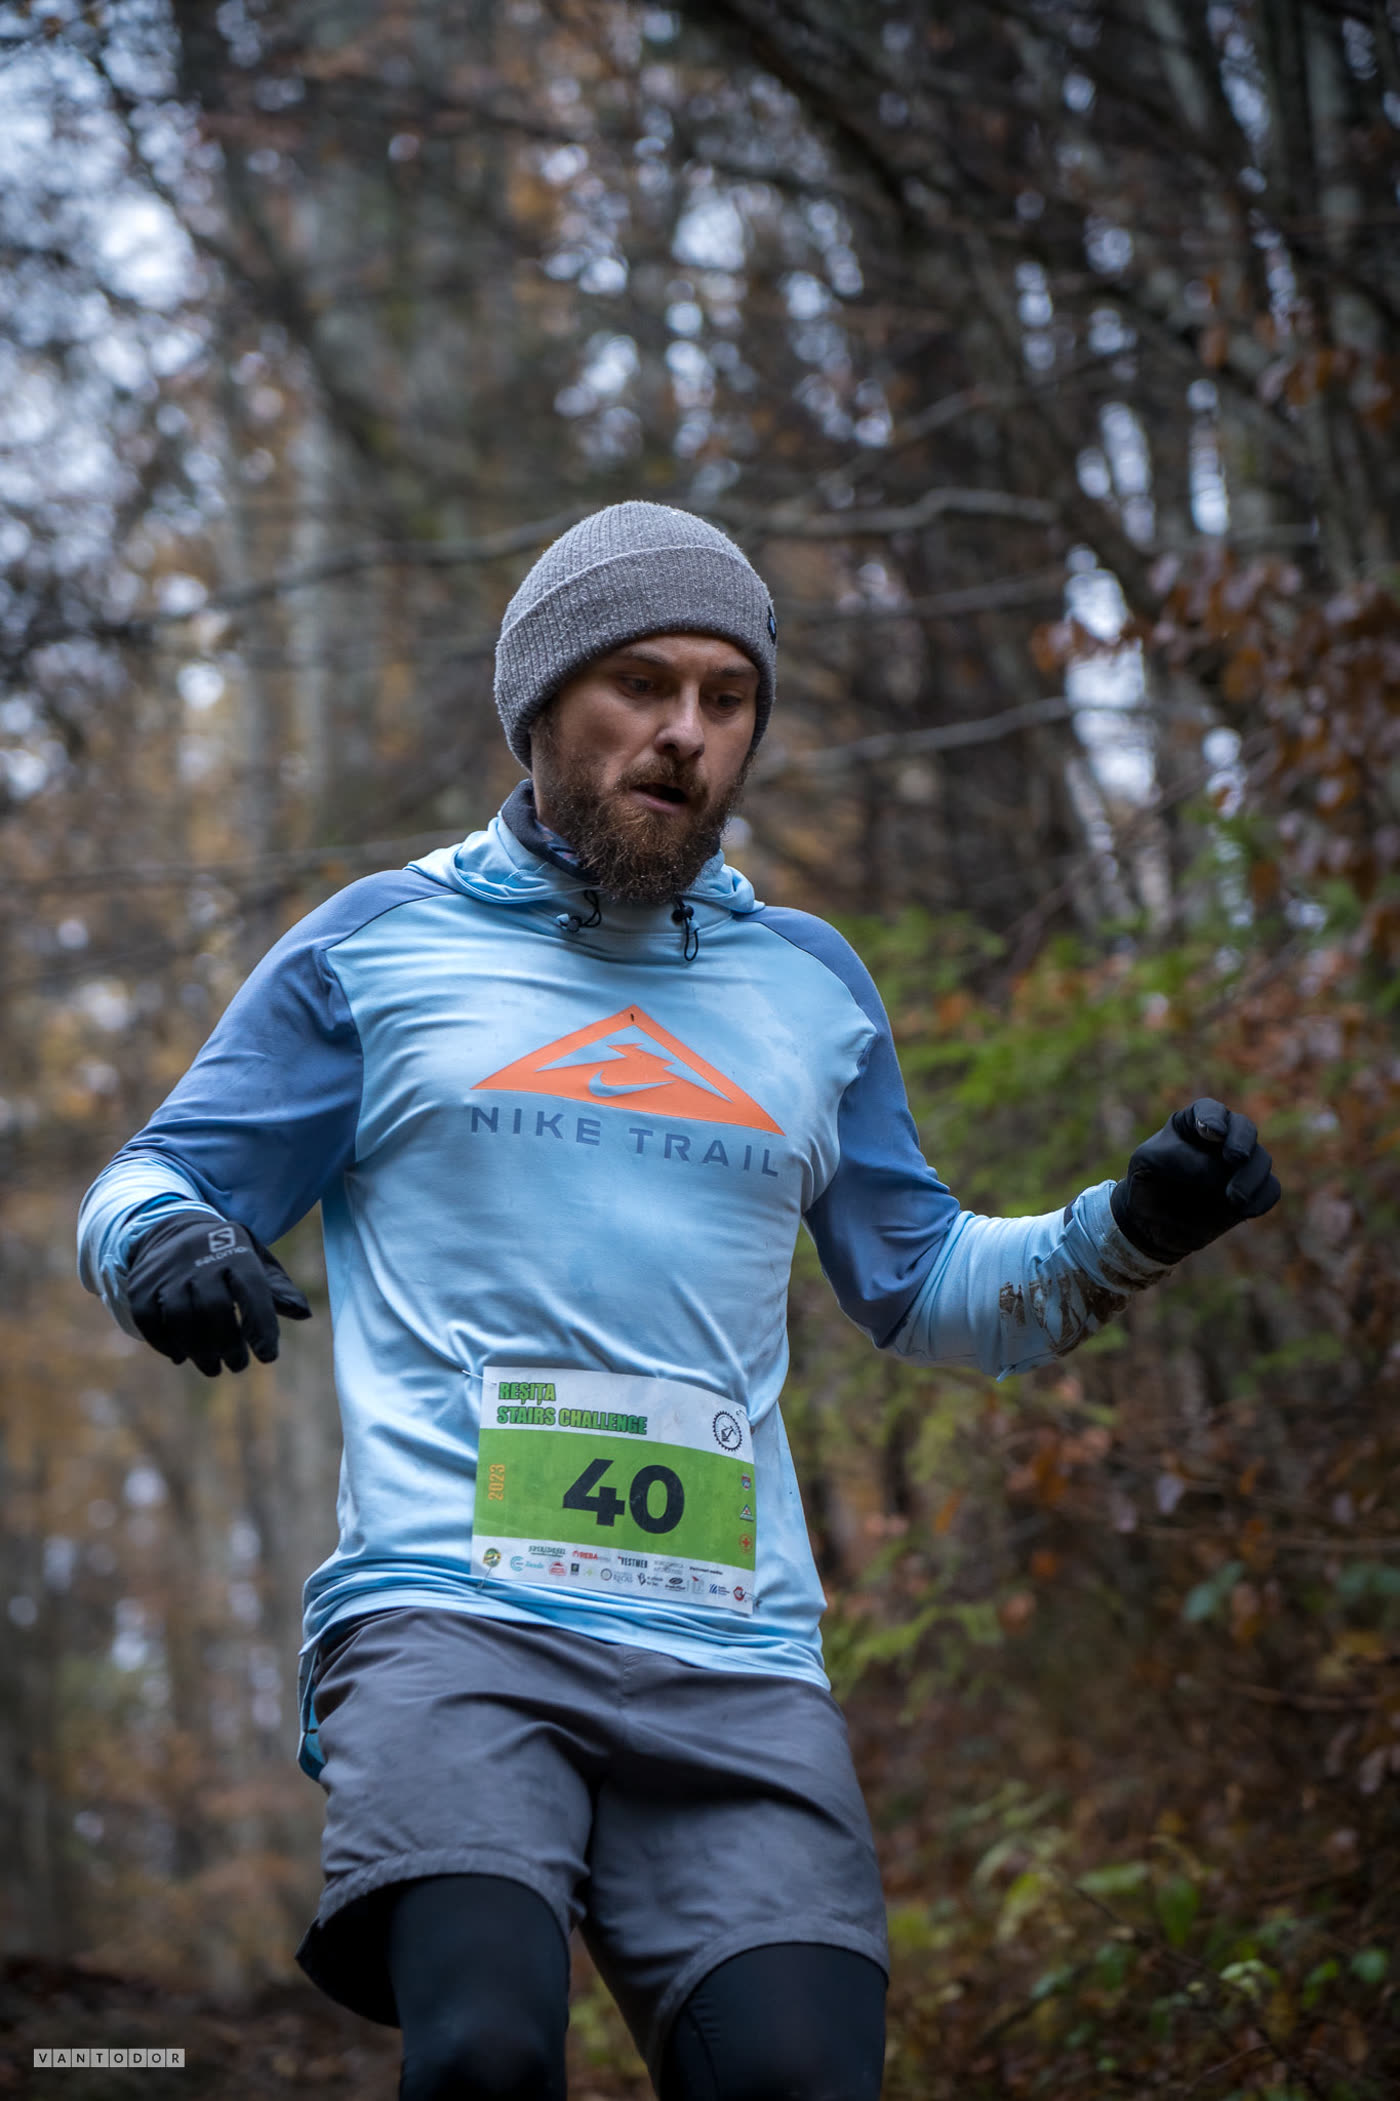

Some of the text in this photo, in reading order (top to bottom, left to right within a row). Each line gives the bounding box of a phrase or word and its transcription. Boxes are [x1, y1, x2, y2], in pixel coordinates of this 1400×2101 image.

[471, 1107, 779, 1178] NIKE TRAIL
[496, 1405, 648, 1436] STAIRS CHALLENGE
[488, 1463, 505, 1501] 2023
[562, 1458, 685, 1534] 40
